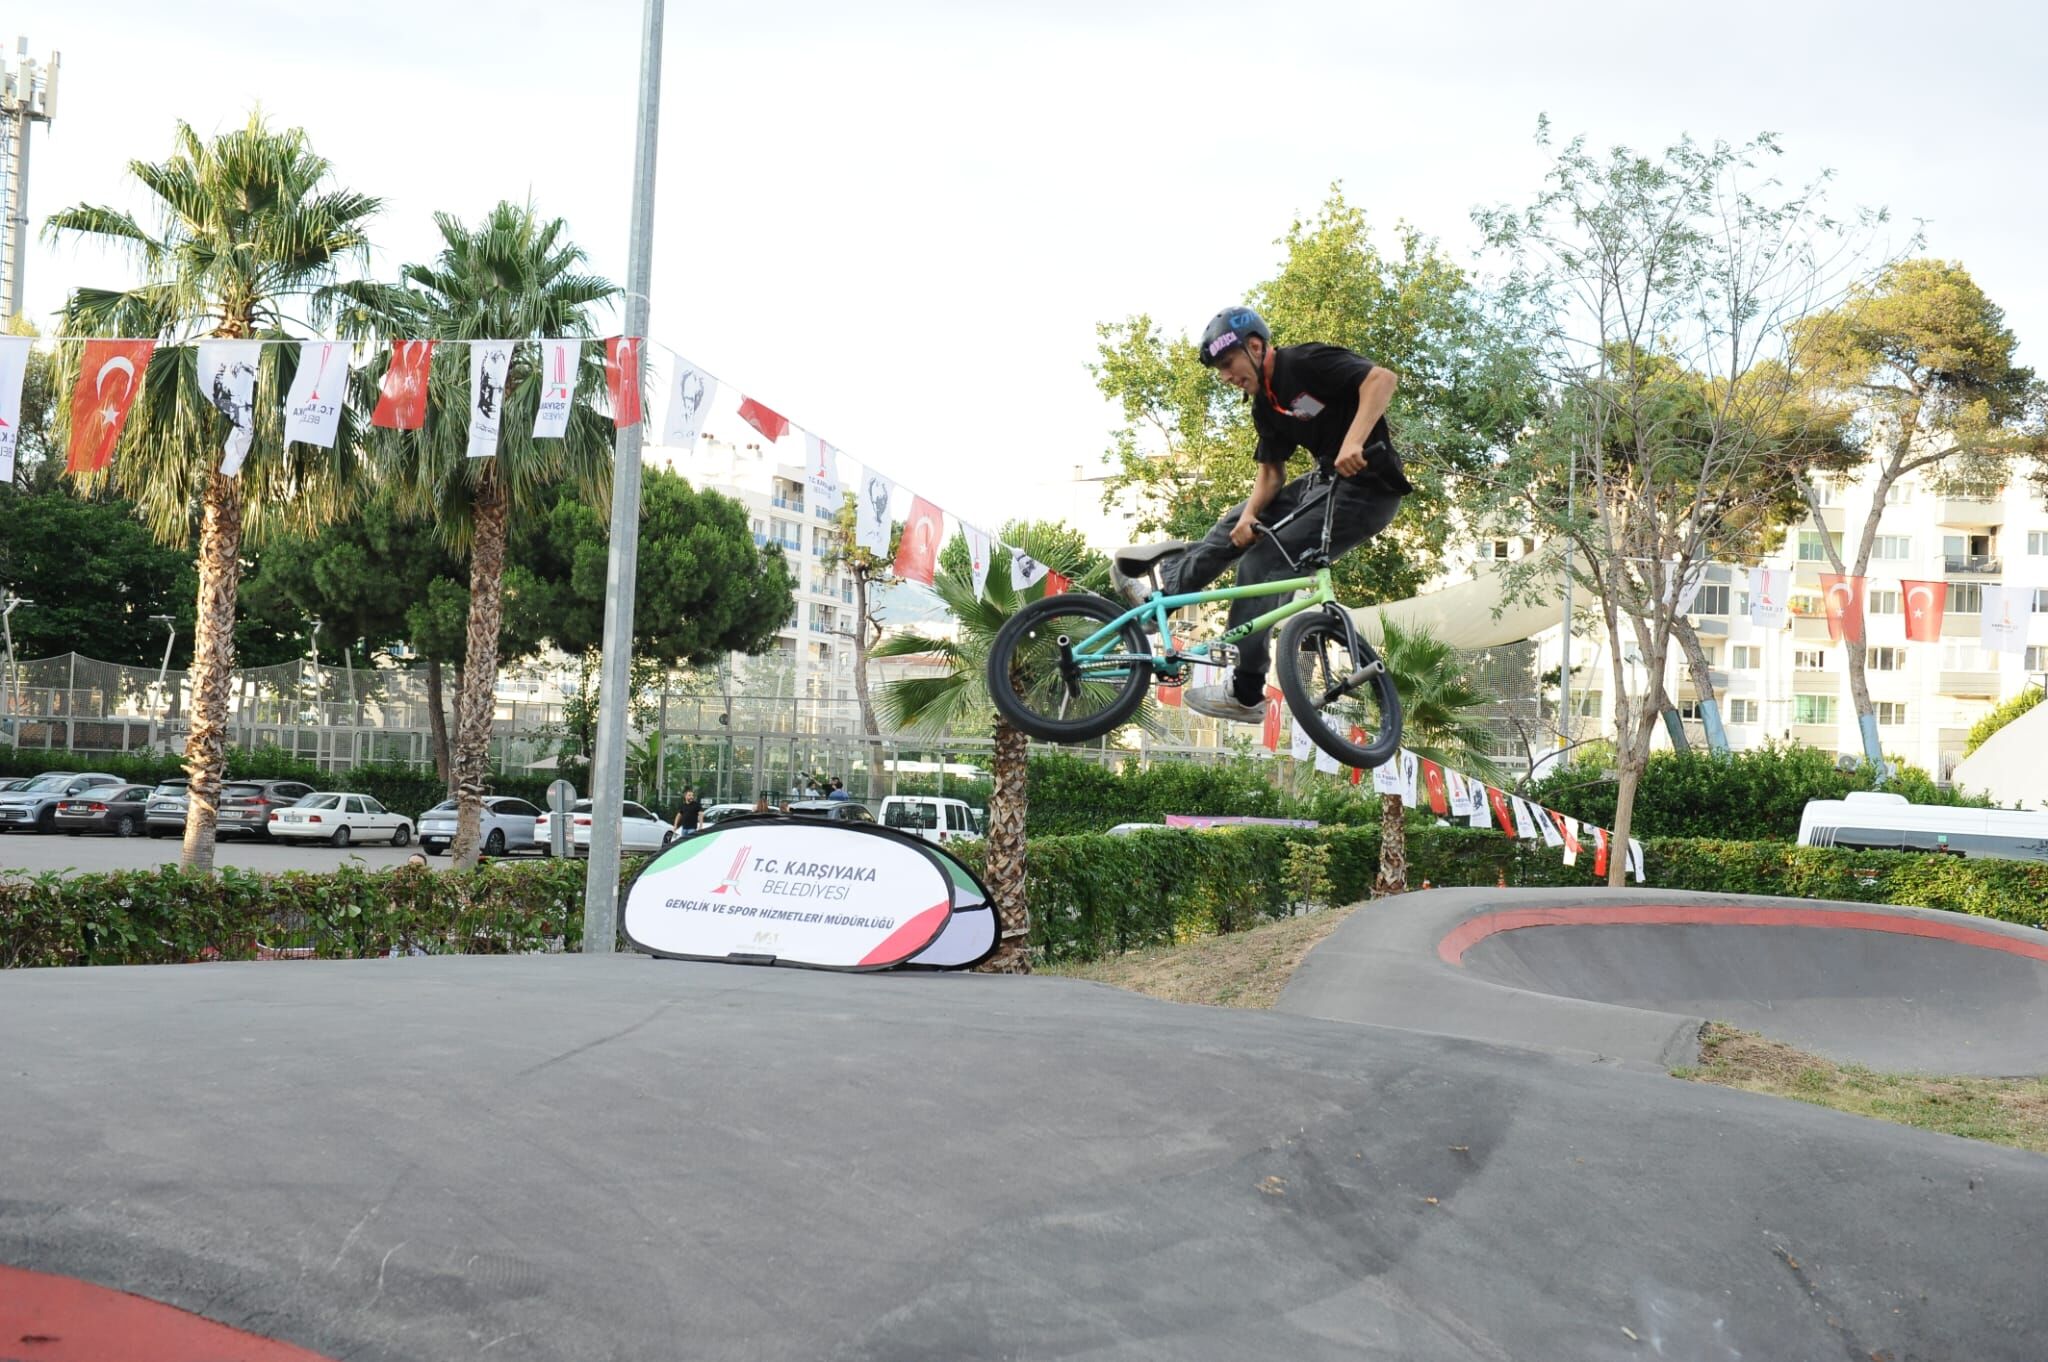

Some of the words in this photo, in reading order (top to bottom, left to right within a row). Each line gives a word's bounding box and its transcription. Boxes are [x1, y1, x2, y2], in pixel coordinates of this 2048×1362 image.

[753, 858, 779, 873] T.C.
[784, 861, 877, 882] KARŞIYAKA
[762, 879, 850, 900] BELEDİYESİ
[665, 898, 710, 912] GENÇLİK
[712, 904, 727, 914] VE
[727, 905, 758, 917] SPOR
[758, 907, 823, 924] HİZMETLERİ
[824, 913, 895, 929] MÜDÜRLÜĞÜ
